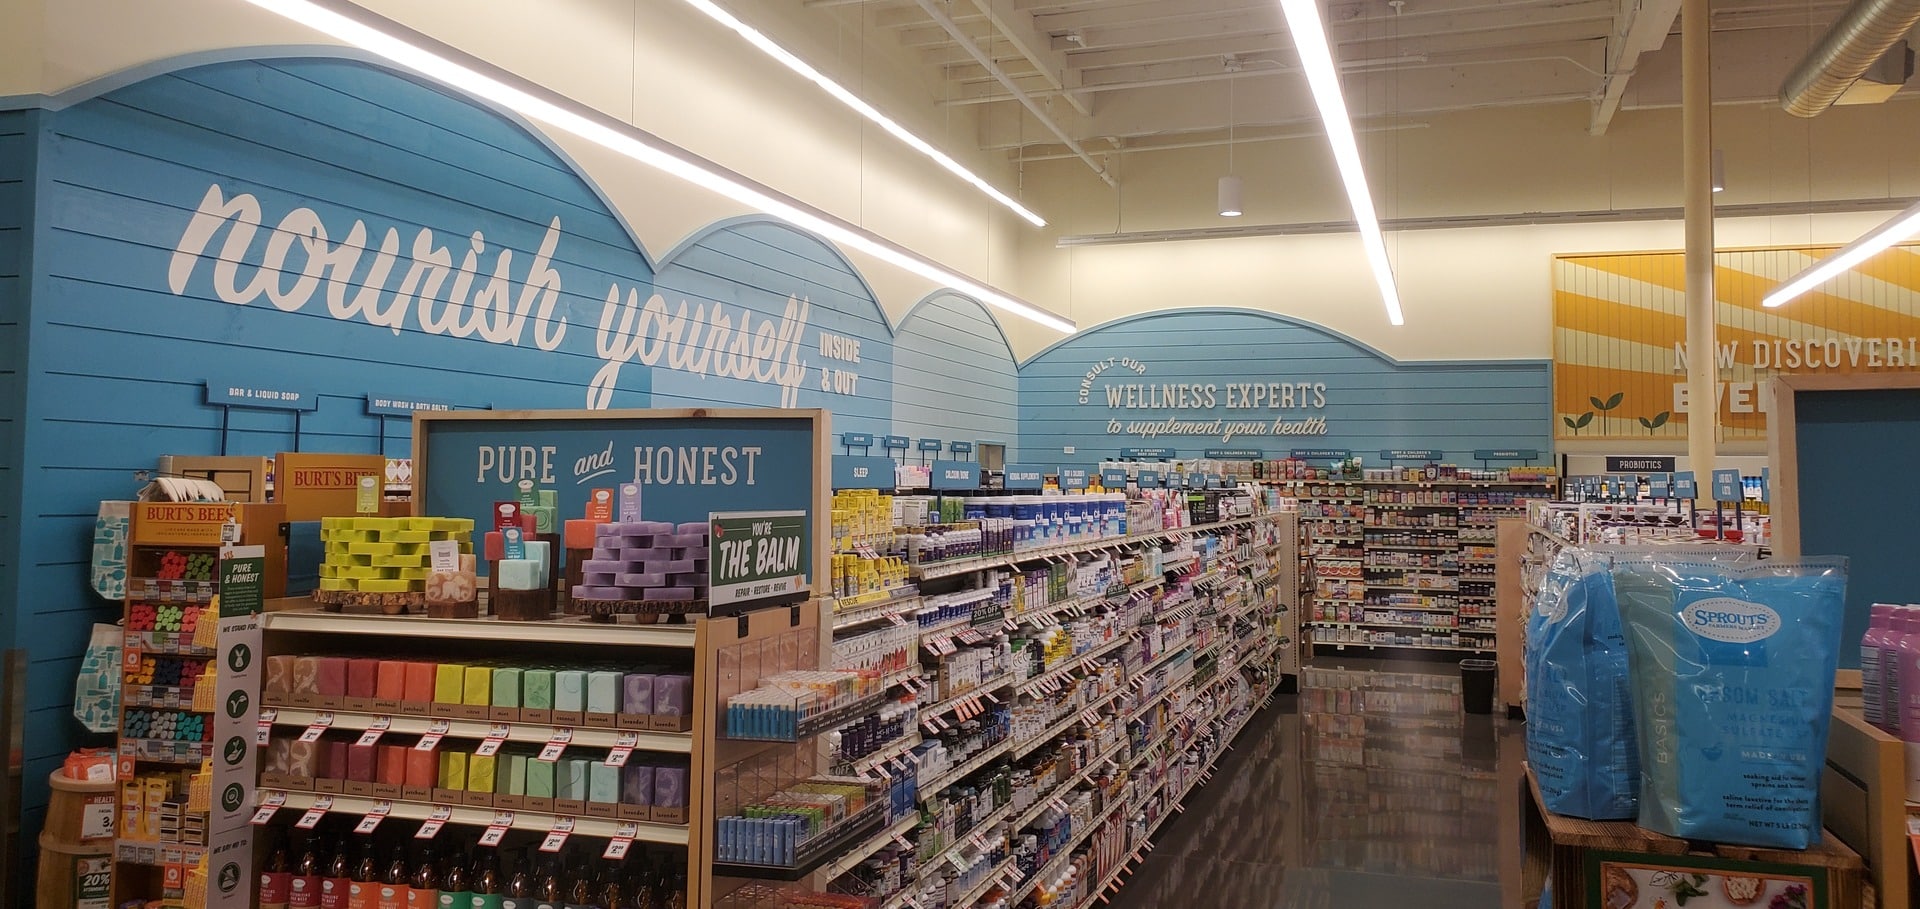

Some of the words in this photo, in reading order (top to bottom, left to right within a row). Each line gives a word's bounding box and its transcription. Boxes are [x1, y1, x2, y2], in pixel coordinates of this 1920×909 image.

[167, 184, 567, 351] nourish
[586, 282, 809, 410] yourself
[819, 332, 861, 364] INSIDE
[1674, 341, 1738, 369] NW
[1753, 337, 1917, 368] DISCOVERI
[821, 368, 831, 392] &
[834, 371, 858, 396] OUT
[1078, 357, 1115, 405] CONSULT
[1121, 357, 1146, 375] OUR
[228, 387, 245, 398] BAR
[247, 388, 253, 398] &
[255, 389, 279, 400] LIQUID
[281, 391, 300, 401] SOAP
[1105, 383, 1218, 409] WELLNESS
[1225, 382, 1327, 409] EXPERTS
[1674, 382, 1767, 413] EE
[375, 399, 391, 408] BODY
[392, 400, 409, 409] WASH
[415, 402, 430, 411] BATH
[431, 404, 448, 412] SALTS
[1106, 418, 1121, 435] to
[1126, 416, 1222, 439] supplement
[1222, 421, 1267, 444] your
[1271, 416, 1328, 436] health
[477, 445, 557, 484] PURE
[573, 440, 616, 479] and
[633, 446, 762, 485] HONEST
[1619, 460, 1662, 470] PROBIOTICS
[295, 471, 341, 486] BURT'S
[853, 467, 868, 478] SLEEP
[147, 507, 194, 520] BURT'S
[199, 507, 235, 521] BEES
[752, 521, 772, 536] YOU'RE
[720, 539, 752, 580] THE
[756, 536, 800, 576] BALM
[232, 563, 252, 573] PURE
[224, 574, 230, 583] &
[231, 573, 259, 583] HONEST
[735, 587, 750, 598] REPAIR
[754, 584, 770, 595] RESTORE
[774, 582, 787, 592] REVIVE
[973, 608, 986, 617] 20%
[987, 605, 998, 613] OFF
[1694, 610, 1767, 625] SPROUTS
[622, 718, 644, 726] lavender
[654, 720, 676, 728] lavender
[1655, 692, 1667, 763] BASICS
[835, 766, 850, 775] OFF
[1743, 774, 1769, 782] soaking
[94, 796, 115, 804] HEALT
[1744, 795, 1771, 803] laxative
[83, 873, 110, 886] 20%
